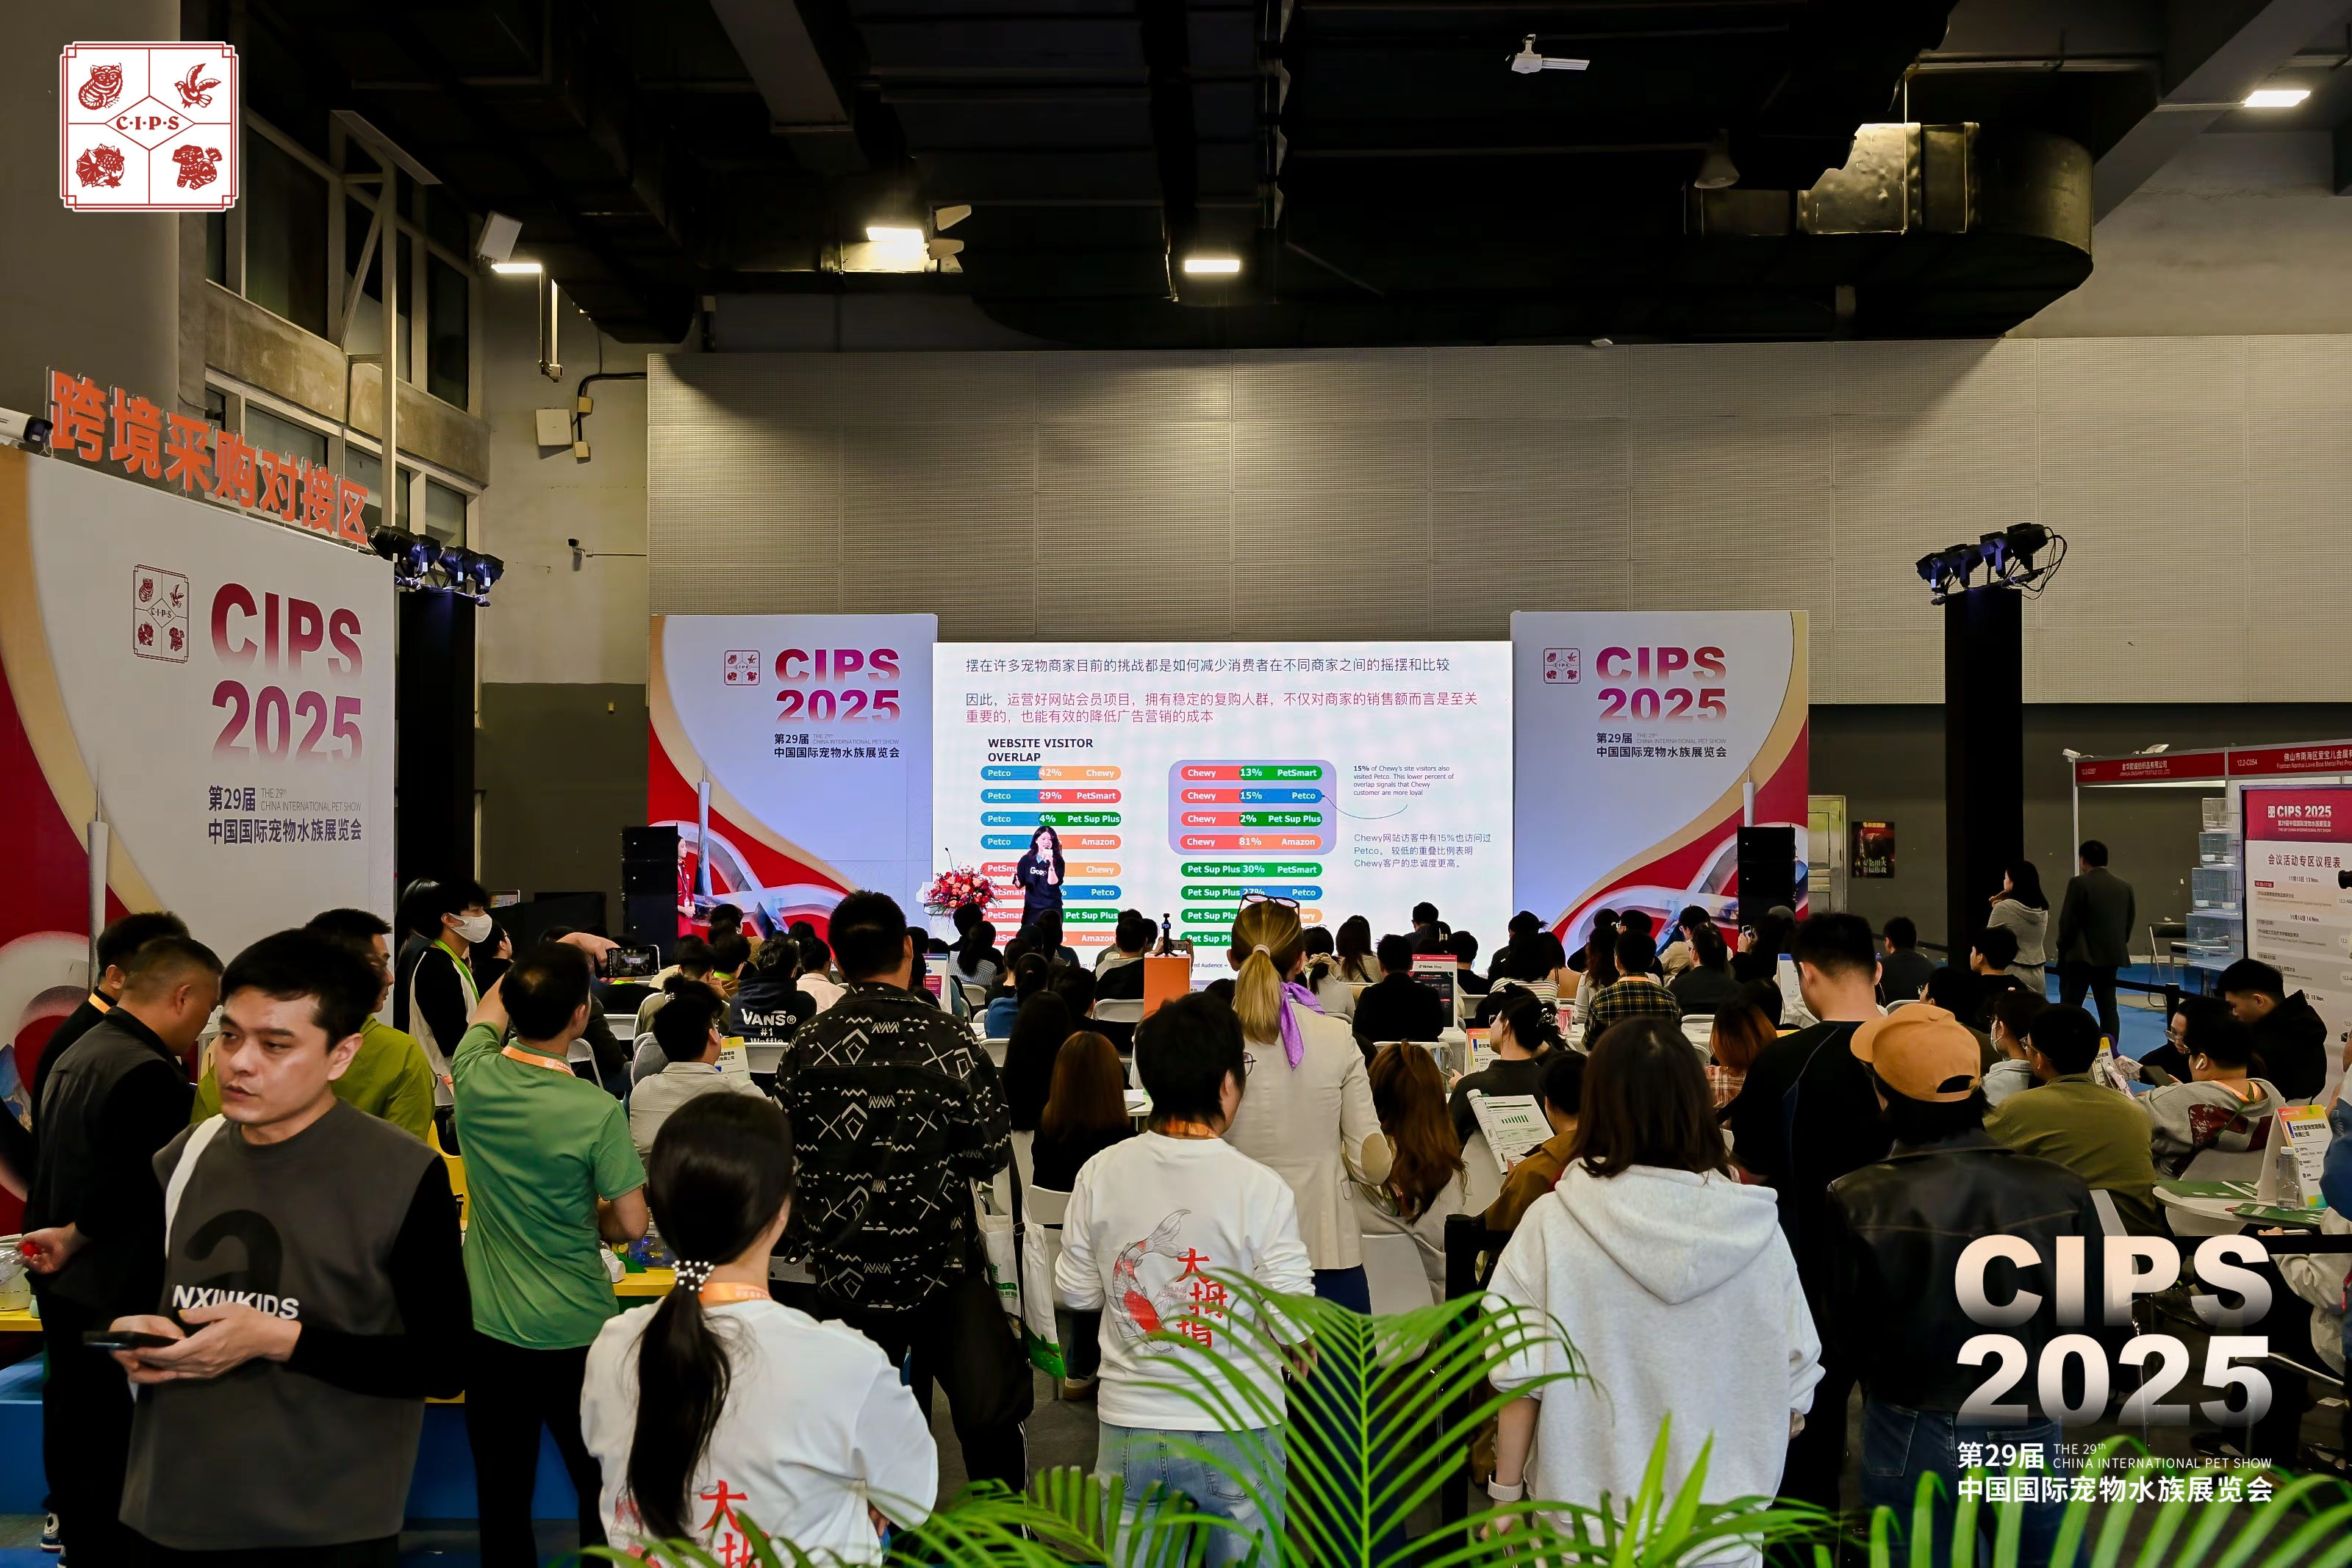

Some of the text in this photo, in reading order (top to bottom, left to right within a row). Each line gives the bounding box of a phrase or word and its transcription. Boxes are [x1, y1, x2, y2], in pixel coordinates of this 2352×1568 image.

[51, 370, 368, 545] 跨境采购对接区
[211, 583, 363, 682] CIPS
[775, 648, 900, 684] CIPS
[966, 658, 1450, 672] 摆在许多宠物商家目前的挑战都是如何减少消费者在不同商家之间的摇摆和比较
[1596, 647, 1727, 683] CIPS
[775, 689, 900, 724] 2025
[1596, 688, 1727, 724] 2025
[966, 710, 1213, 724] 重要的，也能有效的降低广告营销的成本
[212, 680, 363, 766] 2025
[775, 733, 808, 744] 第29届
[988, 738, 1094, 748] WEBSITE VISITOR
[1596, 733, 1632, 744] 第29届
[775, 747, 900, 758] 中国国际宠物水族展览会
[988, 752, 1041, 762] OVERLAP
[1596, 747, 1727, 758] 中国国际宠物水族展览会
[1039, 769, 1062, 777] 42%
[1086, 769, 1114, 778] Chewy
[1188, 769, 1216, 778] Chewy
[1240, 769, 1263, 777] 13%
[208, 785, 256, 811] 第29届
[261, 788, 274, 799] THE
[1039, 791, 1062, 799] 29%
[1188, 792, 1216, 801] Chewy
[1240, 791, 1263, 799] 15%
[261, 801, 361, 811] CHINA INTERNATIONAL PET SHOW
[2277, 805, 2331, 818] CIPS 2025
[1084, 815, 1100, 824] Sup
[1188, 815, 1216, 824] Chewy
[1240, 814, 1257, 822] 2%
[1285, 815, 1301, 824] Sup
[209, 818, 362, 844] 中国国际宠物水族展览会
[1187, 838, 1215, 846] Chewy
[1354, 833, 1491, 844] Chewy网站访客中有15%也访问过
[1354, 859, 1460, 868] Chewy客户的忠诚度更高。
[2268, 854, 2340, 868] 会议活动专区议程表
[1086, 866, 1114, 874] Chewy
[1204, 866, 1220, 874] Sup
[1242, 865, 1265, 873] 30%
[1204, 888, 1220, 898] Sup
[1082, 911, 1097, 921] Sup
[1204, 912, 1220, 921] Sup
[1203, 935, 1219, 943] Sup
[760, 1028, 773, 1037] #1
